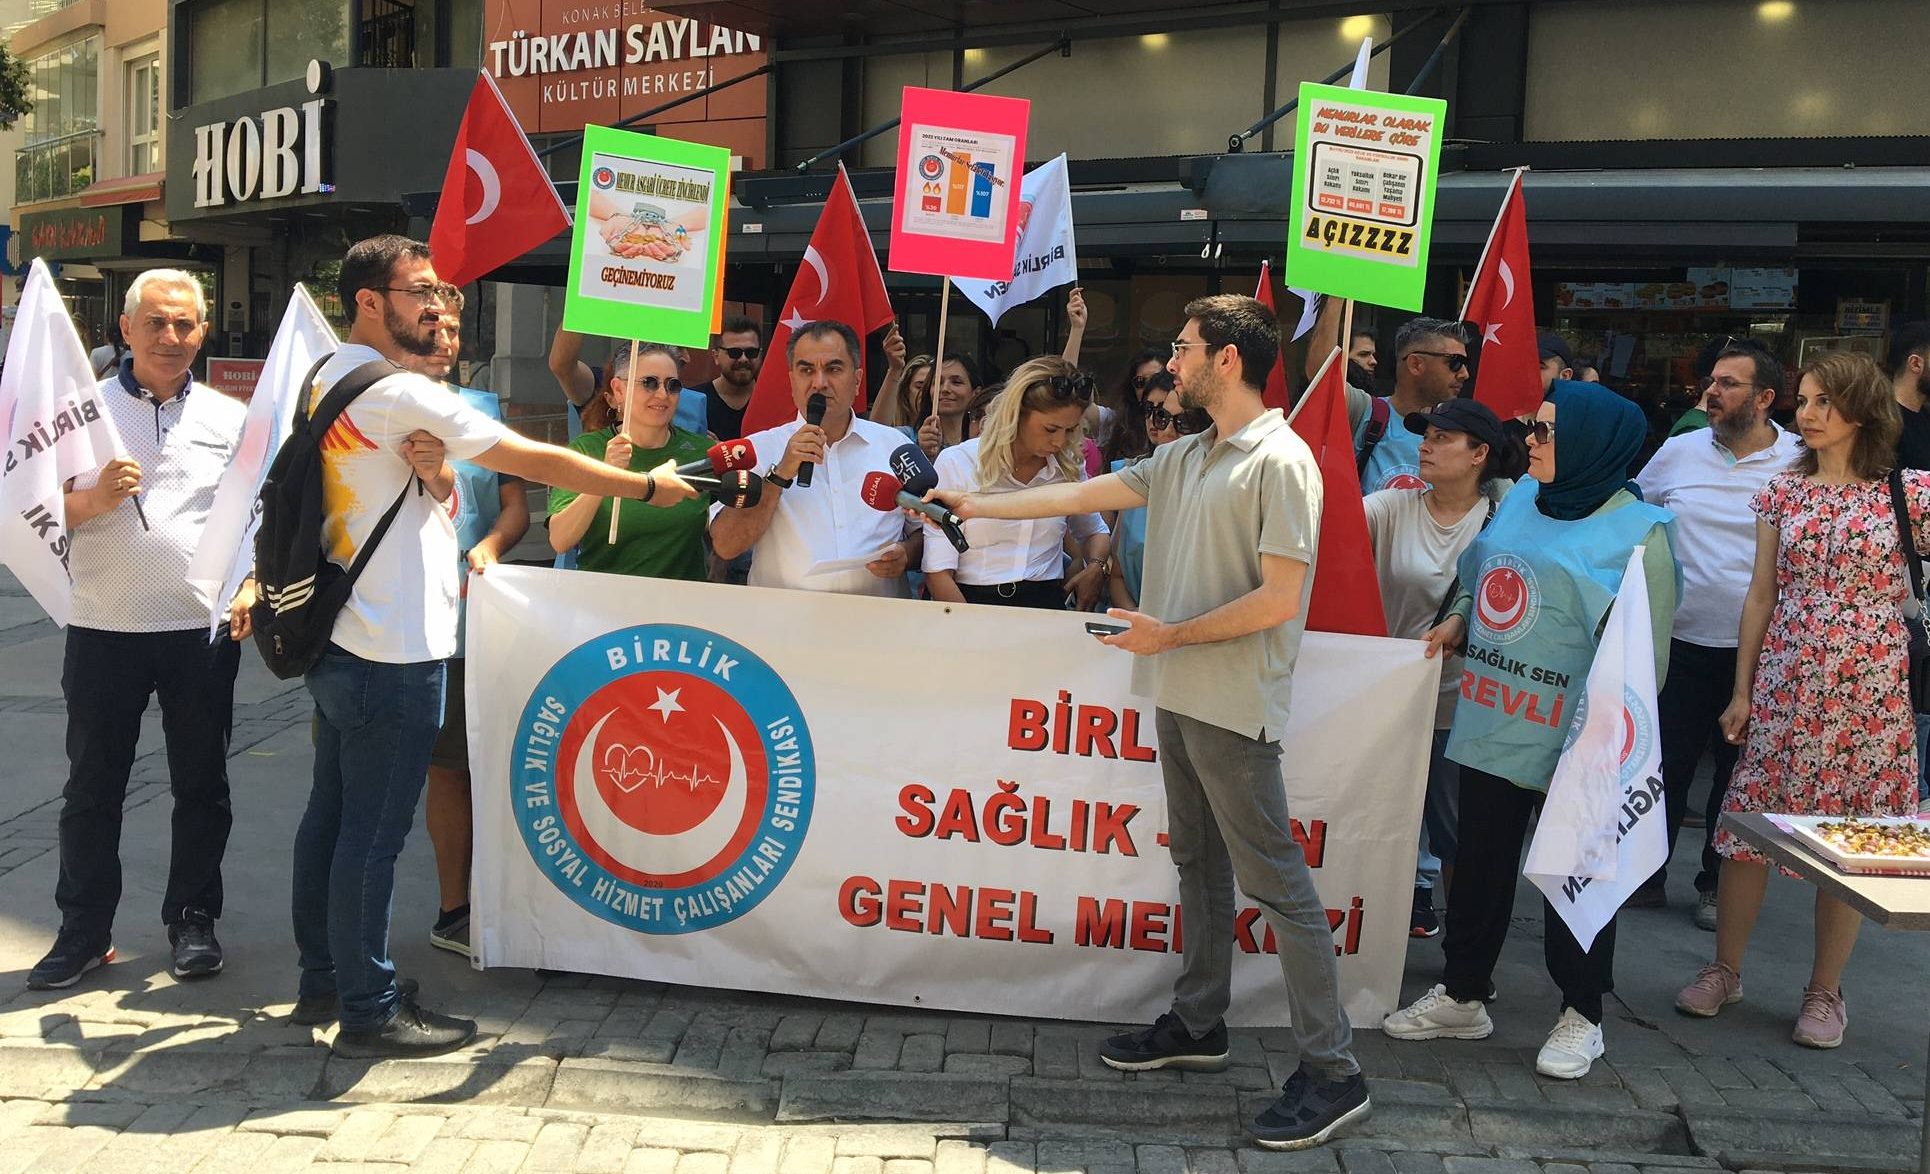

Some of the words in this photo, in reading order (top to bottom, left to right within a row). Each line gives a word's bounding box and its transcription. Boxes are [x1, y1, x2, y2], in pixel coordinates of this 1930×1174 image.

[562, 4, 610, 25] KONAK
[490, 28, 617, 78] TÜRKAN
[625, 19, 761, 65] SAYLAN
[543, 77, 617, 103] KÜLTÜR
[623, 66, 715, 97] MERKEZİ
[192, 59, 325, 208] HOBİ
[1313, 122, 1330, 134] BU
[1334, 125, 1385, 142] VERİLERE
[1389, 132, 1421, 147] GÖRE
[1383, 116, 1432, 133] OLARAK
[1306, 217, 1413, 255] AÇIZZZZ
[601, 265, 676, 290] GEÇİNEMİYORUZ
[721, 444, 733, 469] anka
[606, 635, 739, 682] BİRLİK
[1467, 644, 1529, 678] SAĞLIK
[1530, 667, 1571, 689] SEN
[1459, 669, 1565, 728] REVLİ
[524, 696, 567, 772] SAĞLIK
[1007, 689, 1157, 763] BİRL
[525, 783, 550, 808] VE
[767, 716, 802, 832] SENDİKASI
[895, 779, 1142, 857] SAĞLIK
[533, 815, 589, 886] SOSYAL
[591, 877, 664, 921] HİZMET
[643, 879, 663, 888] 2020
[674, 836, 787, 926] ÇALIŞANLARI
[838, 875, 1054, 944] GENEL
[1074, 896, 1364, 957] MEKİ
